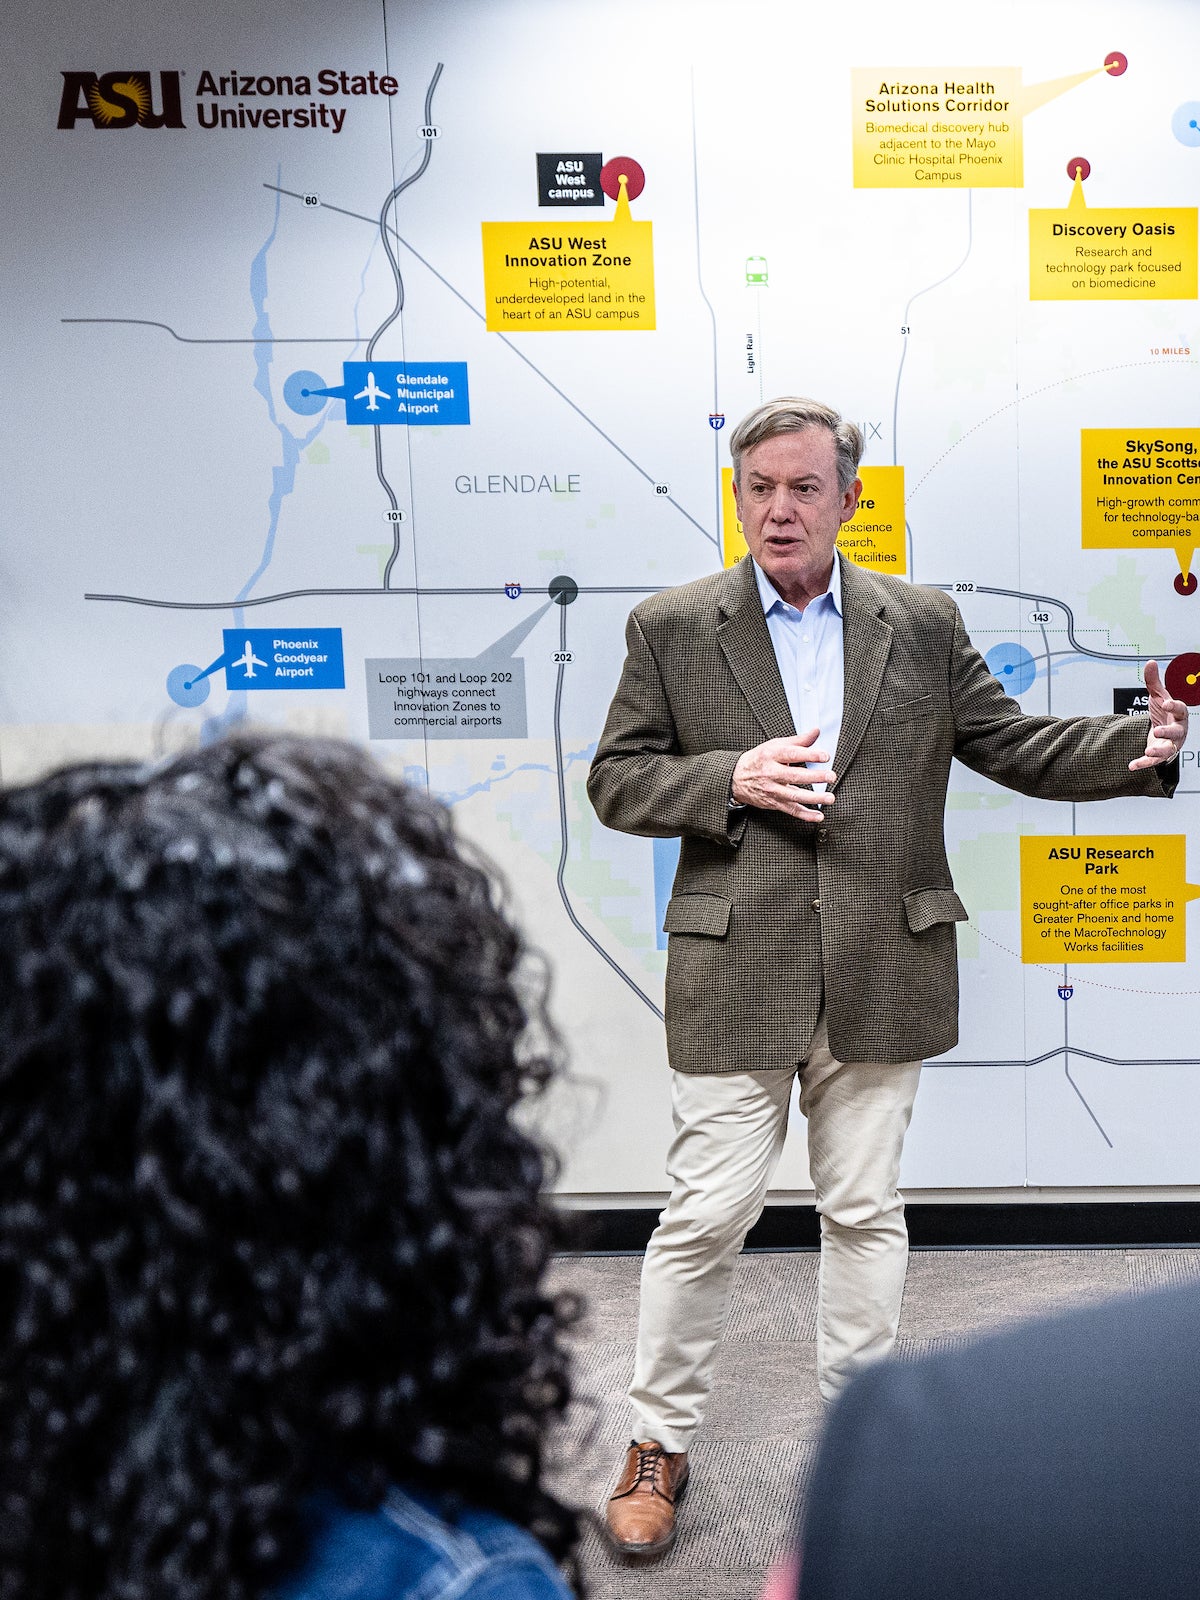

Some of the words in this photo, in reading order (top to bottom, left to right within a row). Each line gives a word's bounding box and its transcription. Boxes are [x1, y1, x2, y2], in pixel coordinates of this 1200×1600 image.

[196, 70, 311, 96] Arizona
[317, 69, 399, 96] State
[878, 82, 939, 95] Arizona
[944, 81, 996, 94] Health
[57, 71, 187, 129] ASU
[865, 99, 940, 112] Solutions
[945, 99, 1010, 112] Corridor
[196, 102, 347, 133] University
[420, 128, 438, 138] 101
[865, 122, 928, 133] Biomedical
[931, 122, 985, 135] discovery
[988, 121, 1010, 132] hub
[879, 139, 928, 151] adjacent
[930, 139, 942, 148] to
[945, 138, 963, 148] the
[966, 138, 997, 151] Mayo
[556, 160, 584, 173] ASU
[873, 154, 905, 165] Clinic
[909, 153, 955, 167] Hospital
[959, 153, 1003, 164] Phoenix
[555, 174, 586, 185] West
[914, 169, 962, 182] Campus
[548, 188, 595, 200] campus
[305, 196, 318, 206] 60
[1052, 223, 1128, 239] Discovery
[1132, 222, 1176, 235] Oasis
[528, 237, 563, 250] ASU
[567, 237, 608, 250] West
[1075, 246, 1128, 257] Research
[1131, 246, 1153, 257] and
[505, 254, 588, 267] Innovation
[592, 254, 632, 267] Zone
[1046, 262, 1107, 276] technology
[1110, 261, 1135, 274] park
[1137, 261, 1182, 272] focused
[529, 277, 611, 291] High-potential,
[1071, 279, 1086, 288] on
[1089, 277, 1157, 288] biomedicine
[495, 293, 585, 306] underdeveloped
[587, 293, 614, 303] land
[615, 292, 625, 303] in
[628, 292, 646, 303] the
[502, 309, 531, 320] heart
[534, 308, 548, 319] of
[549, 310, 563, 319] an
[566, 308, 592, 319] ASU
[595, 309, 640, 321] campus
[900, 326, 911, 335] 51
[746, 333, 754, 351] Rail
[1149, 348, 1160, 356] 10
[1161, 347, 1191, 356] MILES
[747, 352, 756, 375] Light
[396, 373, 449, 385] Glendale
[397, 388, 455, 401] Municipal
[397, 402, 440, 416] Airport
[710, 418, 723, 428] 17
[1125, 439, 1199, 456] SkySong,
[1097, 457, 1119, 469] the
[1122, 457, 1152, 469] ASU
[454, 473, 582, 495] GLENDALE
[1102, 473, 1173, 486] Innovation
[656, 485, 669, 495] 60
[1096, 496, 1165, 510] High-growth
[386, 512, 403, 521] 101
[1103, 511, 1119, 522] for
[1132, 527, 1192, 539] companies
[836, 537, 877, 549] search,
[853, 551, 898, 563] facilities
[506, 587, 519, 598] 10
[955, 583, 974, 593] 202
[1032, 613, 1049, 623] 143
[272, 638, 319, 650] Phoenix
[273, 653, 329, 665] Goodyear
[553, 652, 573, 663] 202
[274, 666, 315, 679] Airport
[378, 672, 408, 685] Loop
[410, 672, 431, 684] 101
[434, 672, 457, 684] and
[459, 672, 488, 686] Loop
[490, 672, 513, 684] 202
[397, 687, 450, 701] highways
[451, 687, 497, 699] connect
[393, 701, 450, 713] Innovation
[452, 701, 488, 712] Zones
[489, 701, 501, 712] to
[394, 715, 458, 727] commercial
[460, 714, 503, 729] airports
[1047, 847, 1082, 861] ASU
[1085, 846, 1156, 860] Research
[1084, 862, 1120, 876] Park
[1060, 884, 1084, 896] One
[1086, 884, 1099, 896] of
[1100, 884, 1118, 895] the
[1120, 884, 1147, 895] most
[1032, 899, 1097, 912] sought-after
[1099, 898, 1130, 910] office
[1132, 898, 1163, 911] parks
[1164, 898, 1175, 909] in
[1032, 913, 1075, 925] Greater
[1076, 912, 1119, 924] Phoenix
[1121, 913, 1142, 924] and
[1144, 912, 1175, 923] home
[1040, 927, 1052, 938] of
[1053, 927, 1072, 938] the
[1073, 926, 1168, 940] MacroTechnology
[1063, 941, 1099, 953] Works
[1100, 940, 1145, 952] facilities
[1059, 988, 1072, 1001] 10
